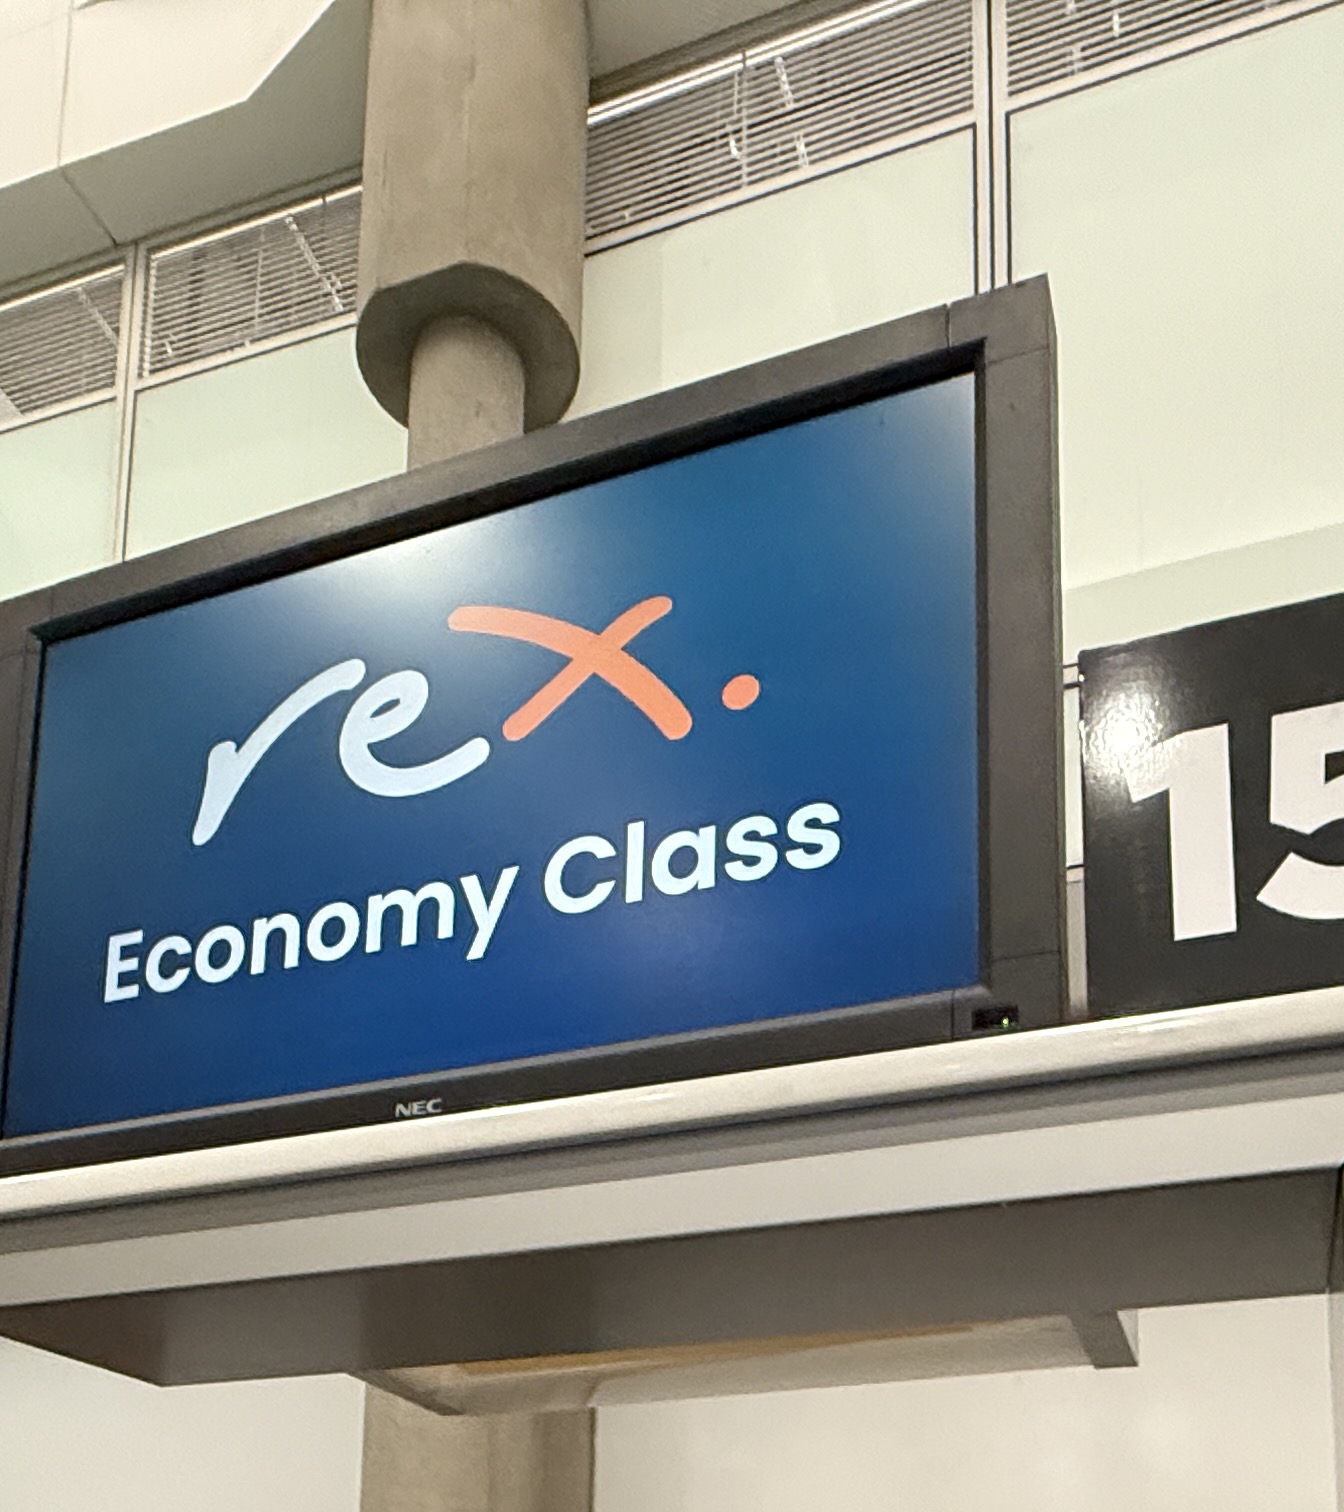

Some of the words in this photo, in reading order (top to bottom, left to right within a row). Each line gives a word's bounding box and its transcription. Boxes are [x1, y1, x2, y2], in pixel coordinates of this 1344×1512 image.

[104, 865, 520, 1003] Economy
[544, 802, 842, 915] Class
[395, 1097, 443, 1118] NEC
